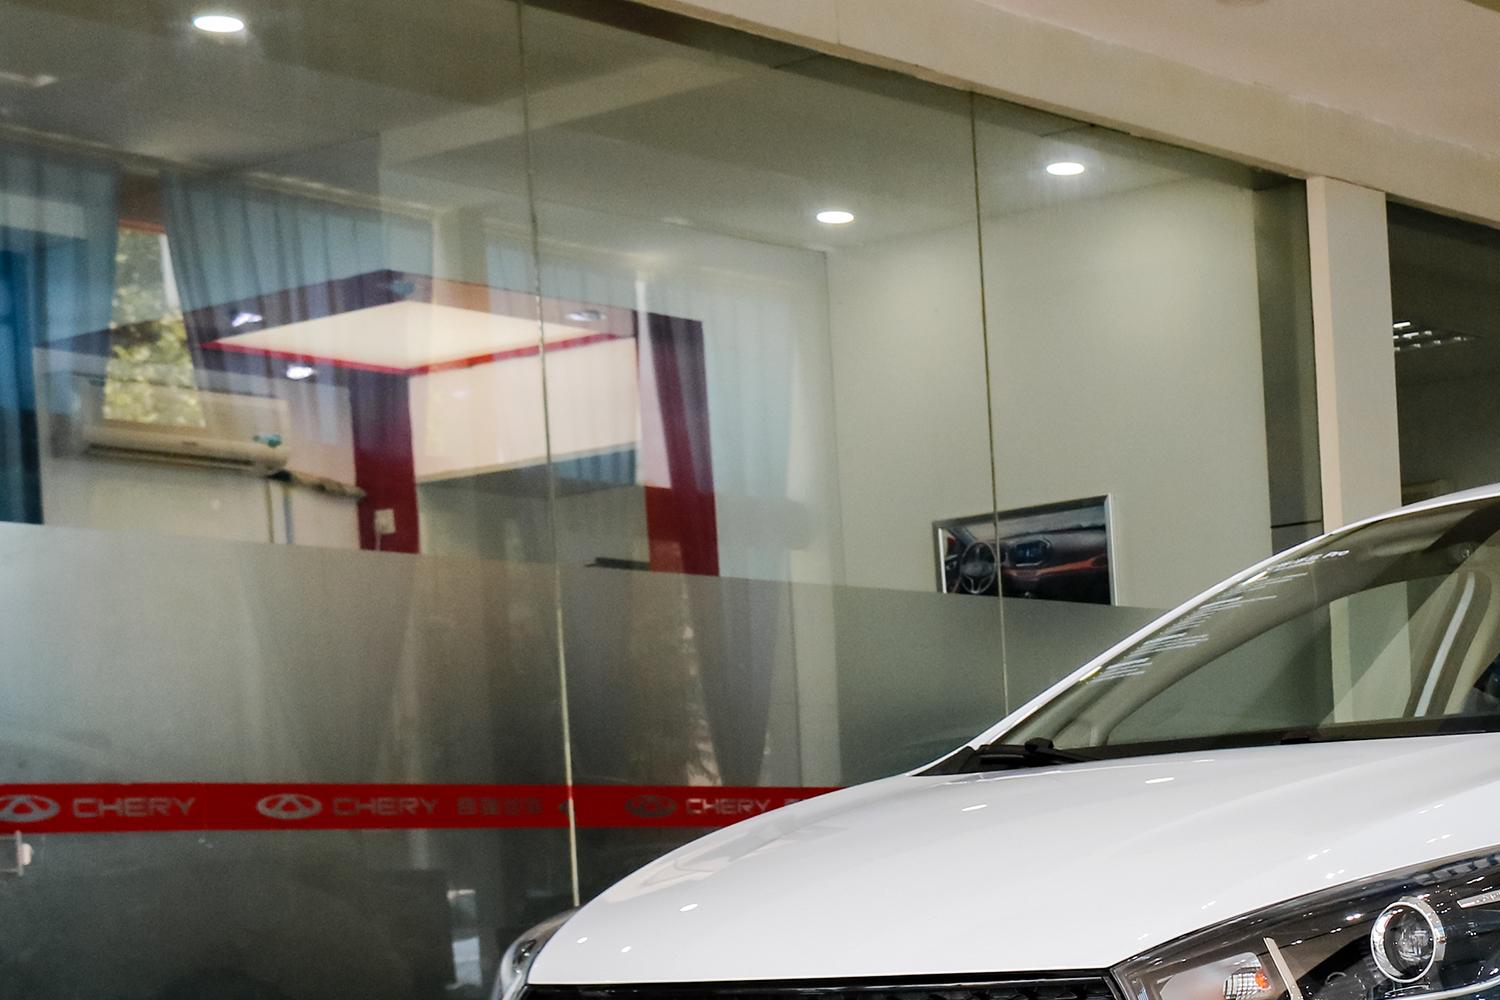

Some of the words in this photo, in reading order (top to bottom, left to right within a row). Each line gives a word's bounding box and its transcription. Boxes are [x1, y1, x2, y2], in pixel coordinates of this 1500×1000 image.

[72, 797, 196, 818] CHERY
[332, 797, 439, 816] CHERY
[685, 798, 771, 815] CHERY
